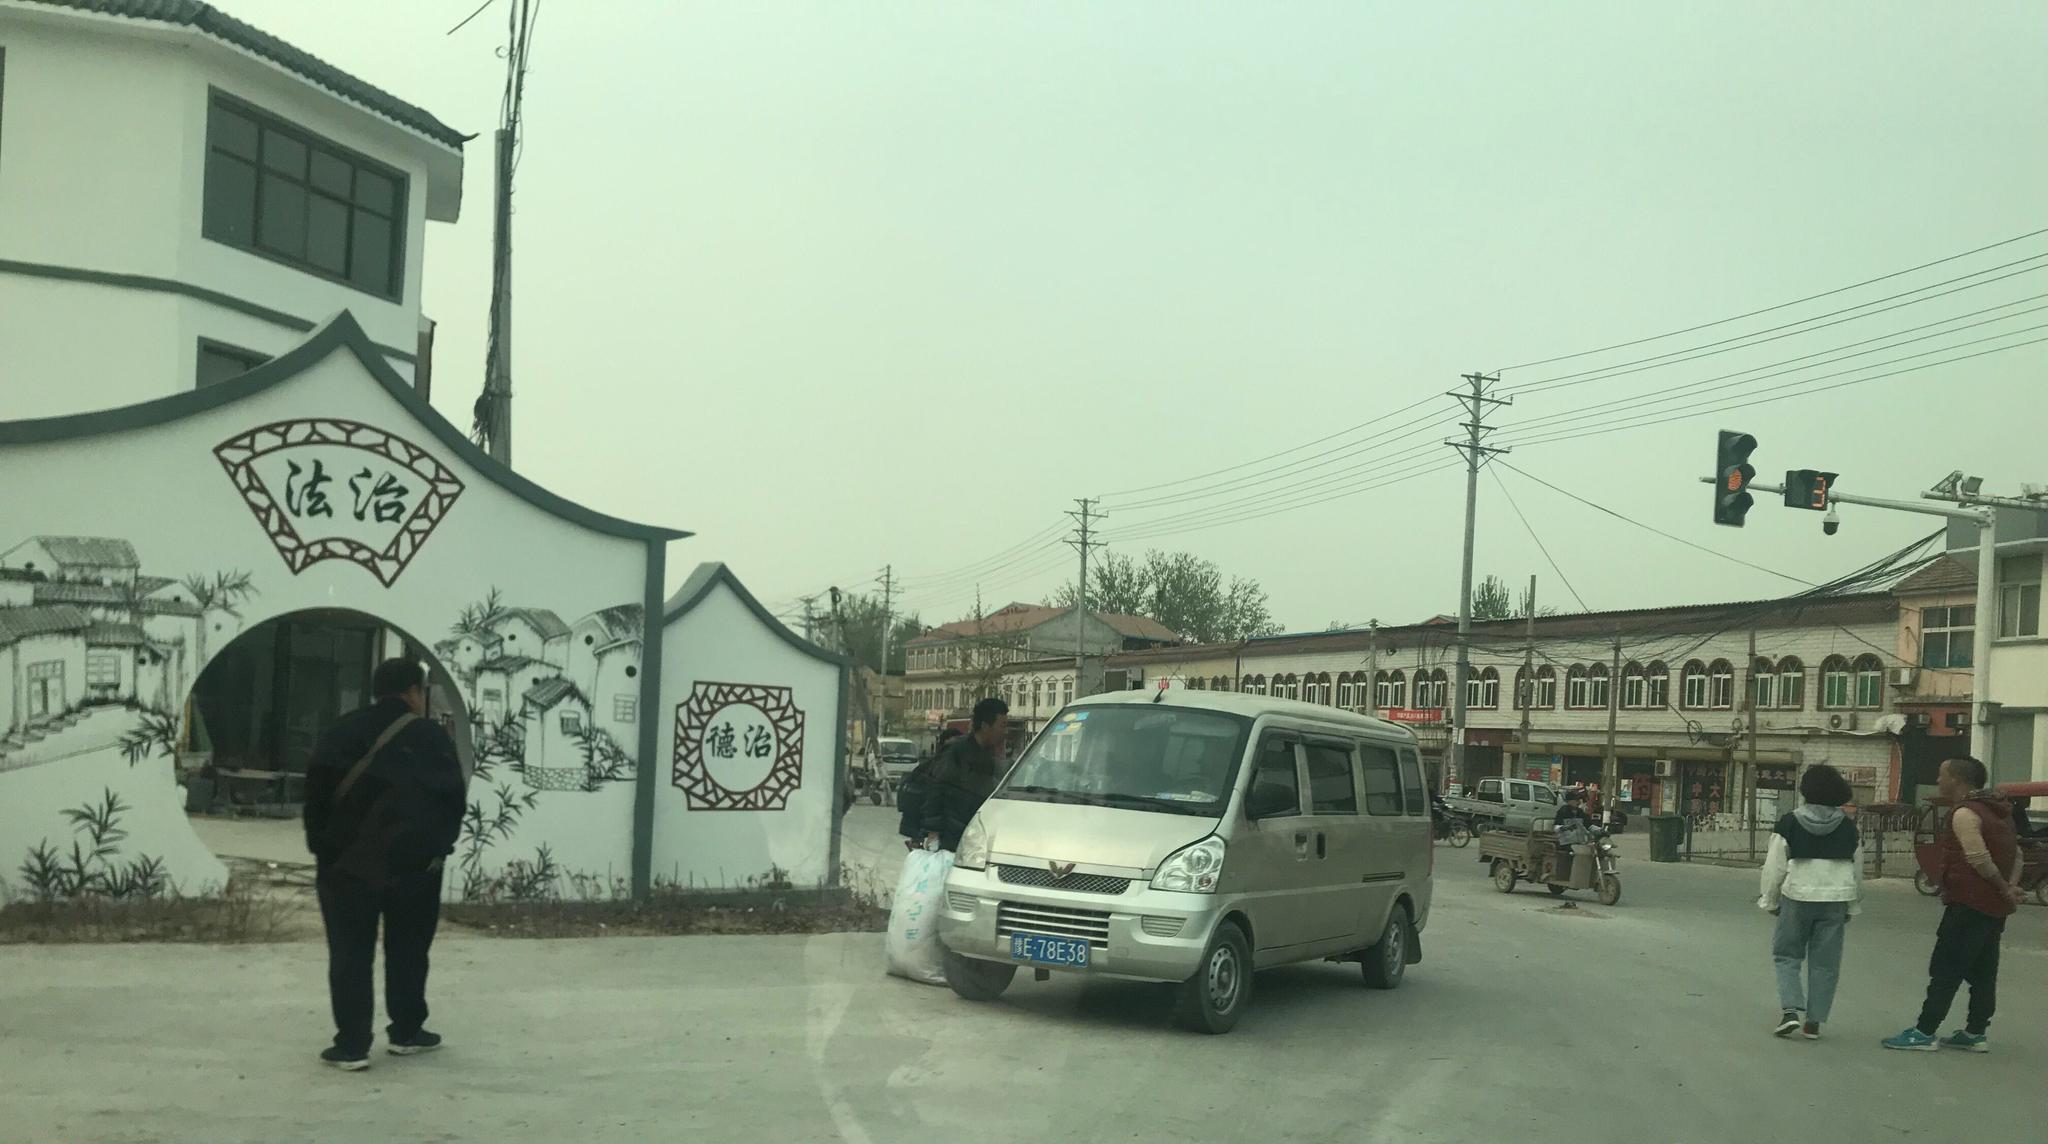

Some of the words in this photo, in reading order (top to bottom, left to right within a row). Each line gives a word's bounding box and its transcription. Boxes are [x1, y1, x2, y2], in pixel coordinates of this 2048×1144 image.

[286, 458, 409, 523] 法治
[1812, 476, 1826, 507] 3
[705, 721, 772, 759] 德治
